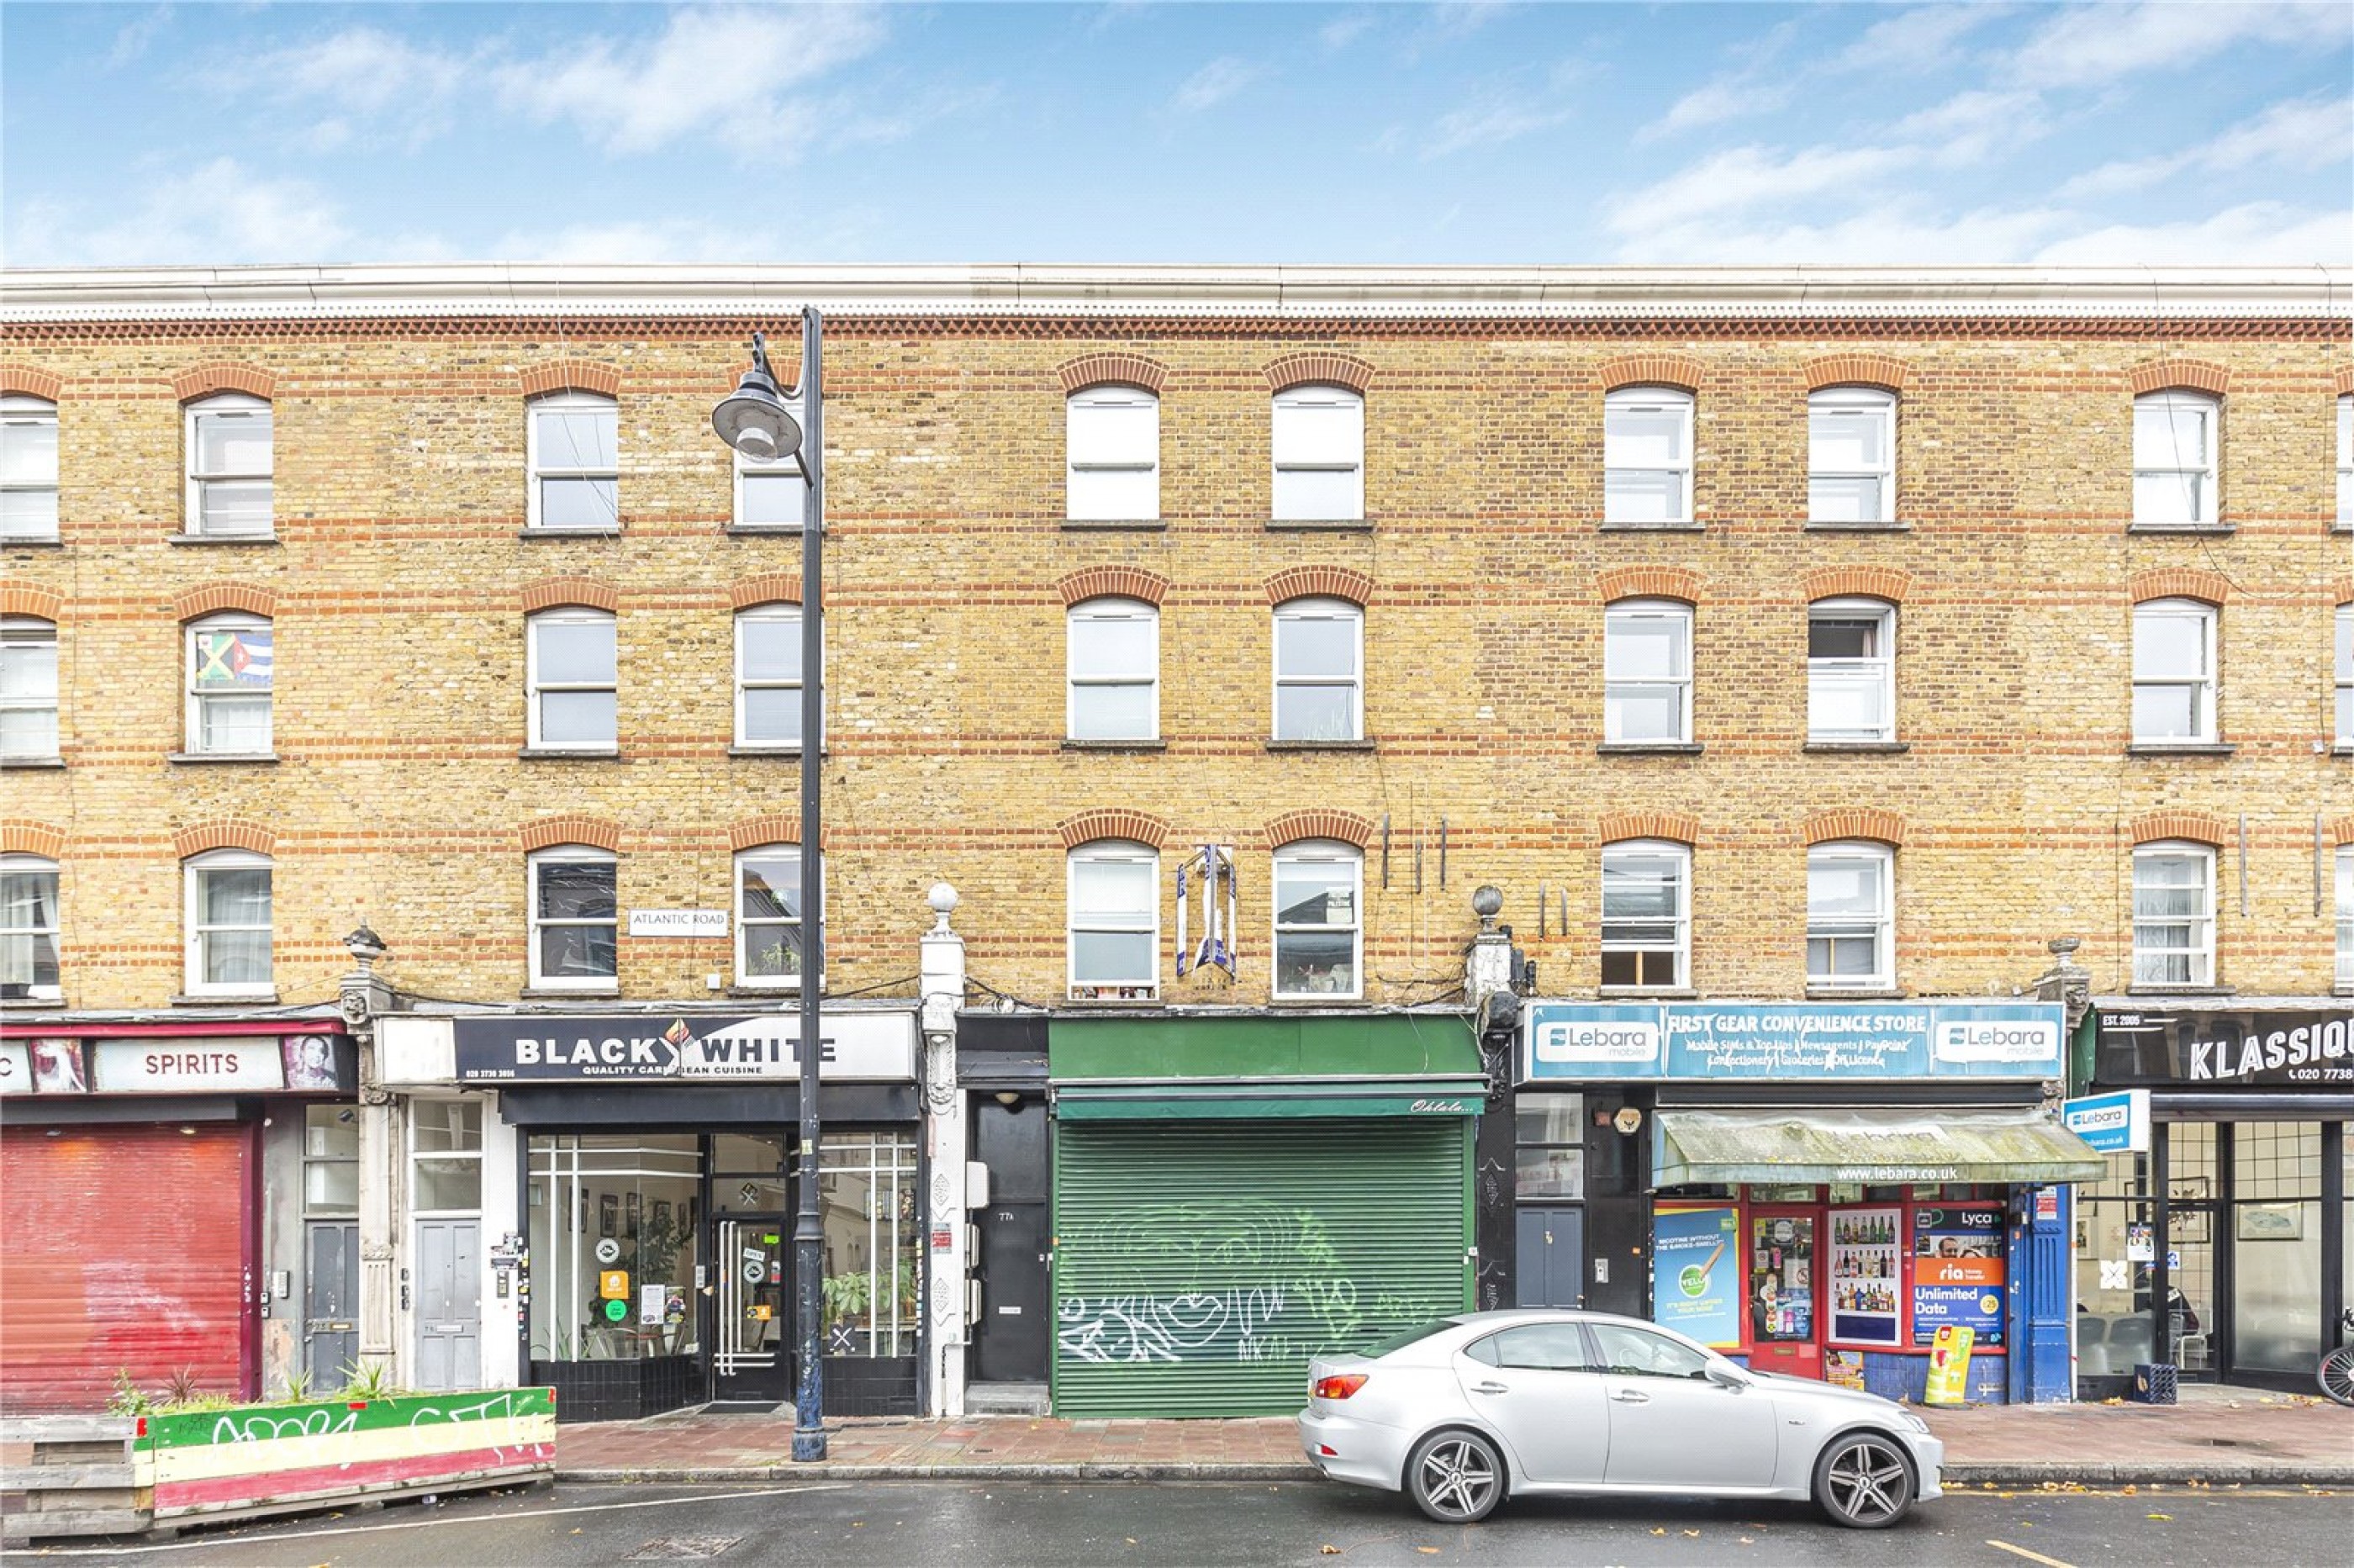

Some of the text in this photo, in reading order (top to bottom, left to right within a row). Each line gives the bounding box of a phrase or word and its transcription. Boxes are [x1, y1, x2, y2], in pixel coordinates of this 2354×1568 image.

[634, 914, 725, 925] ATLANTIC ROAD
[1669, 1015, 1926, 1032] FIRST GEAR CONVENIENCE STORE
[2103, 1015, 2119, 1026] EST.
[1569, 1027, 1646, 1047] Lebara
[1968, 1027, 2045, 1045] Lebara
[515, 1037, 658, 1064] BLACK
[1608, 1047, 1645, 1057] mobile
[145, 1053, 239, 1075] SPIRITS
[582, 1066, 636, 1075] QUALITY
[714, 1066, 763, 1075] CUISINE
[2298, 1069, 2353, 1080] 020 7738
[2082, 1110, 2123, 1125] Lebara
[1837, 1166, 1958, 1180] www.lebara.co.uk
[1961, 1212, 1992, 1225] Lyca
[1689, 1233, 1720, 1242] WITHOUT
[1940, 1263, 1964, 1280] ria
[1915, 1286, 1978, 1301] Unlimited
[1915, 1301, 1948, 1315] Data
